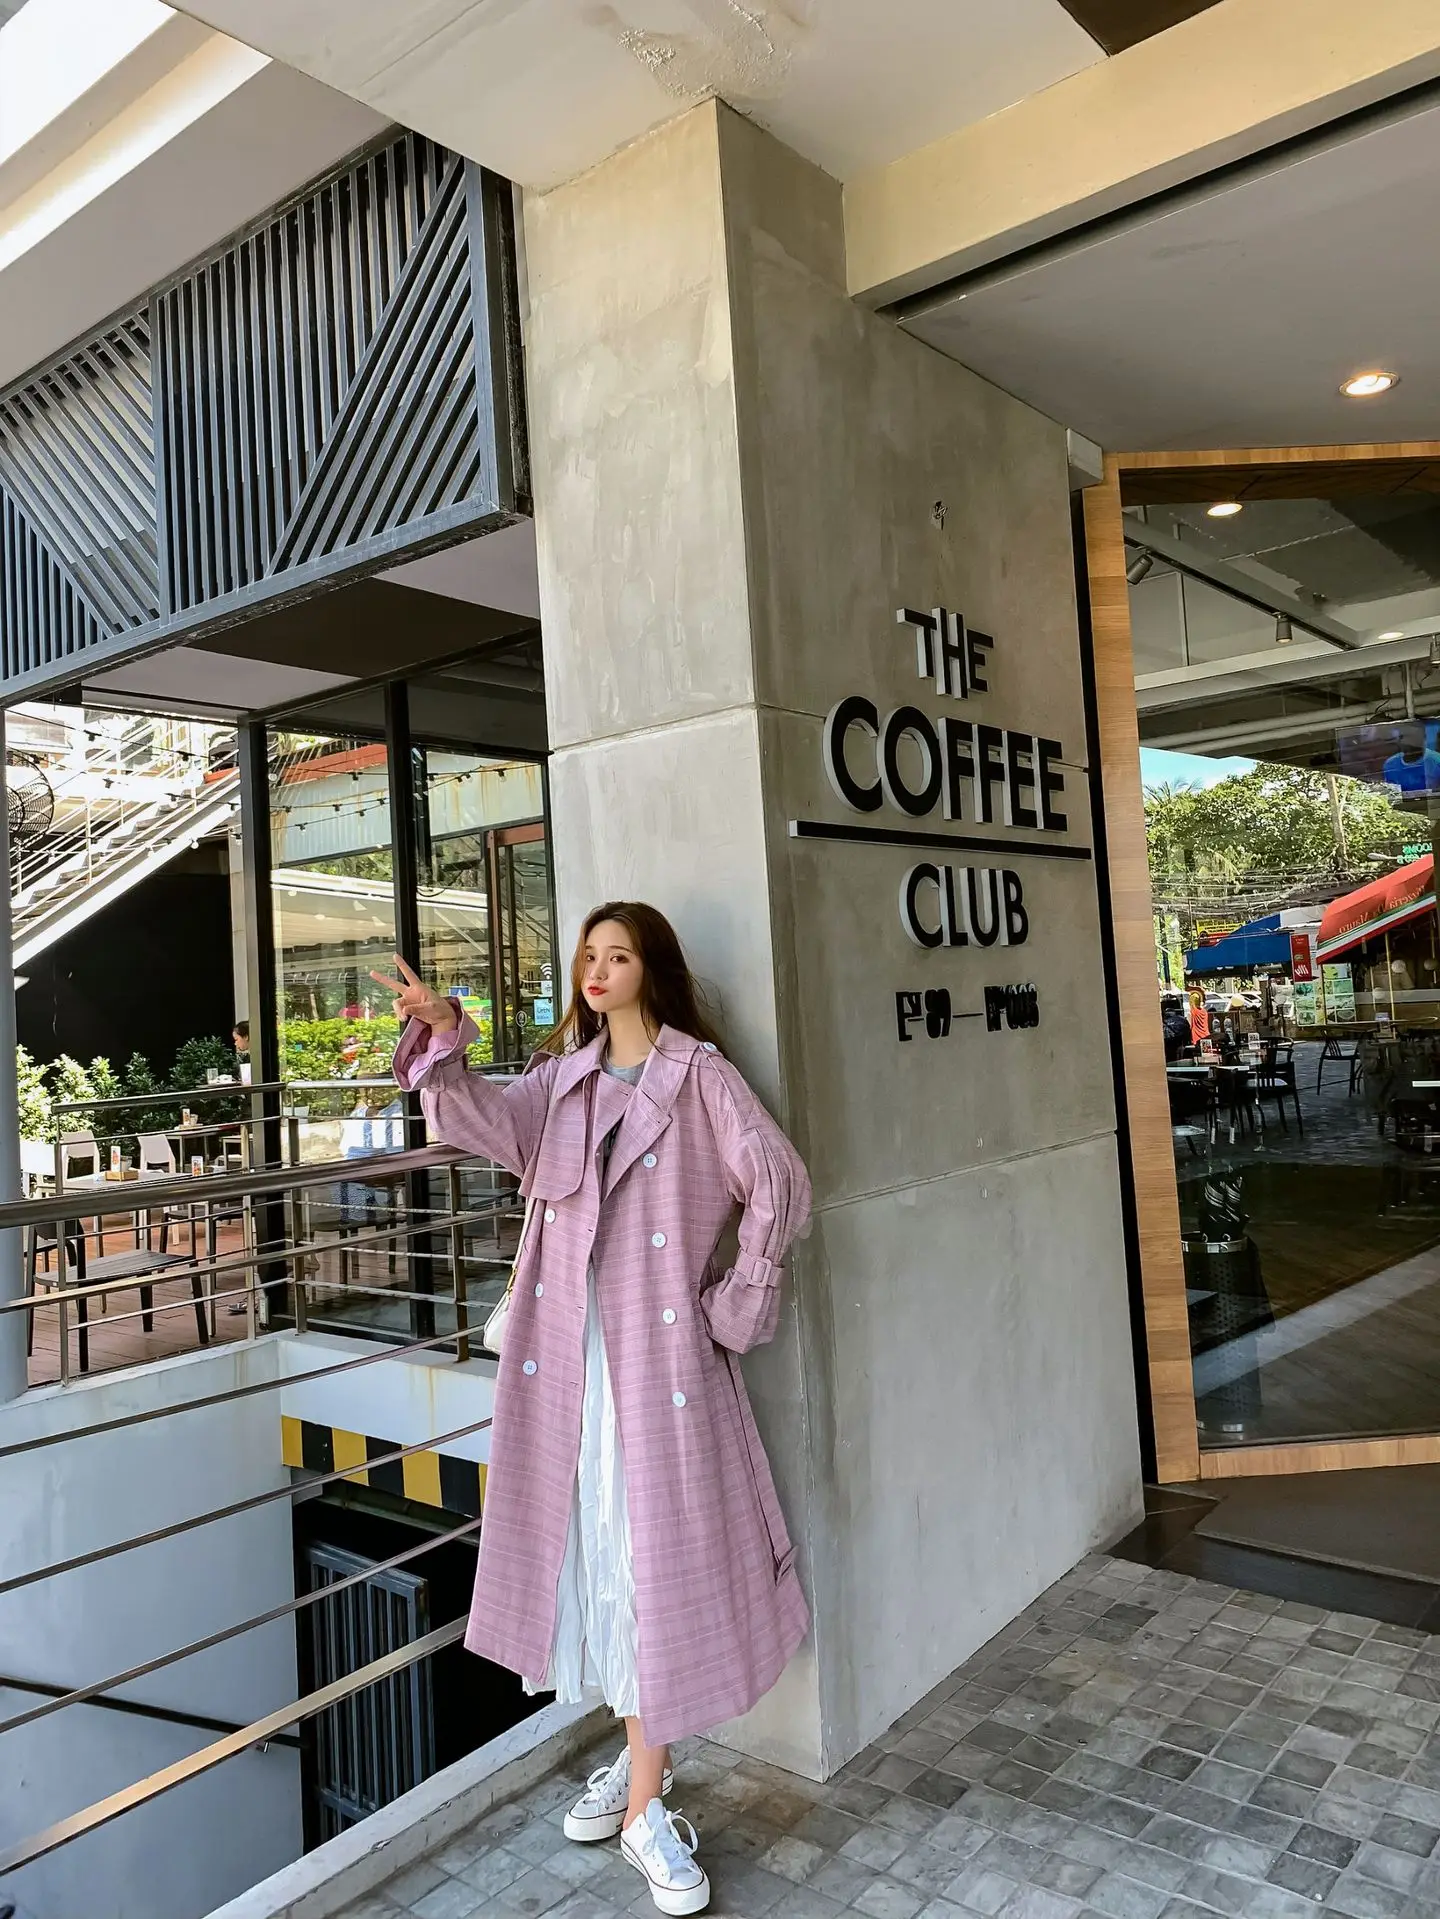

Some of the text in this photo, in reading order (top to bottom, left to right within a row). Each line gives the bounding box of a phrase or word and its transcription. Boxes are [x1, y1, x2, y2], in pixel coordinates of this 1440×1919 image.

[897, 607, 994, 700] THE
[822, 695, 1068, 832] COFFEE
[899, 862, 1029, 949] CLUB
